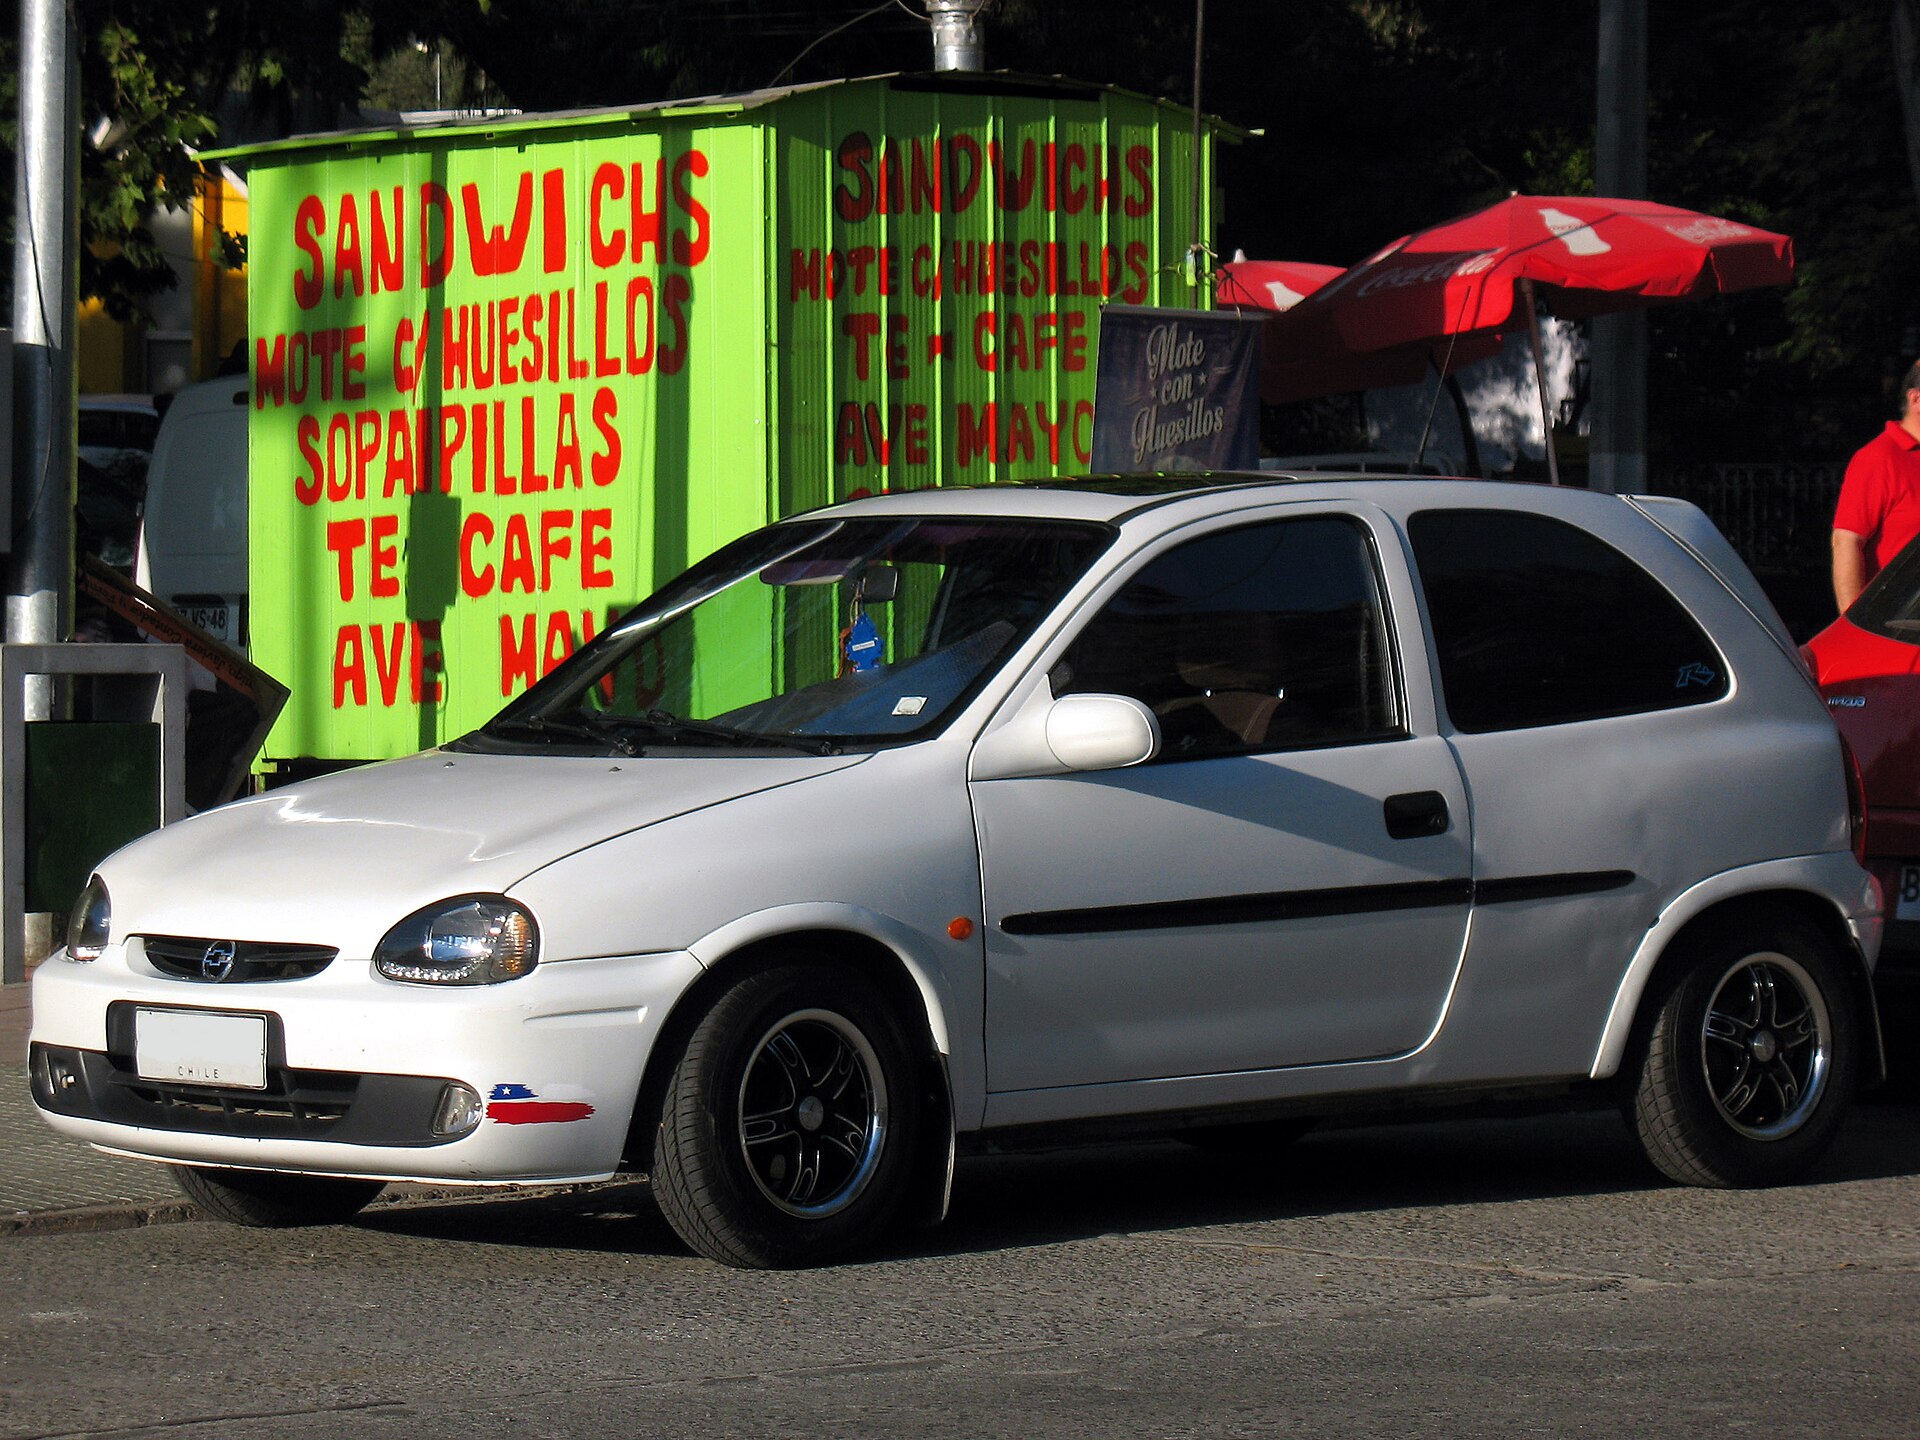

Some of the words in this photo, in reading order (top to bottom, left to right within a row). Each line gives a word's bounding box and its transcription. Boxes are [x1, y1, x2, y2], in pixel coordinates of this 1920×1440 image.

[835, 131, 1153, 222] SANDWICHS
[294, 149, 710, 309] SANDWICHS
[791, 245, 898, 303] MOTE
[256, 325, 366, 409] MOTE
[842, 313, 910, 381] TE
[973, 311, 1088, 373] CAFE
[1146, 321, 1206, 381] Mote
[1161, 372, 1194, 406] con
[294, 387, 623, 506] SOPAIPILLAS
[837, 402, 928, 466] AVE
[1131, 397, 1224, 465] Huesillos
[327, 514, 400, 602] TE
[460, 508, 614, 598] CAFE
[333, 619, 442, 708] AVE
[177, 1065, 219, 1079] CHILE
